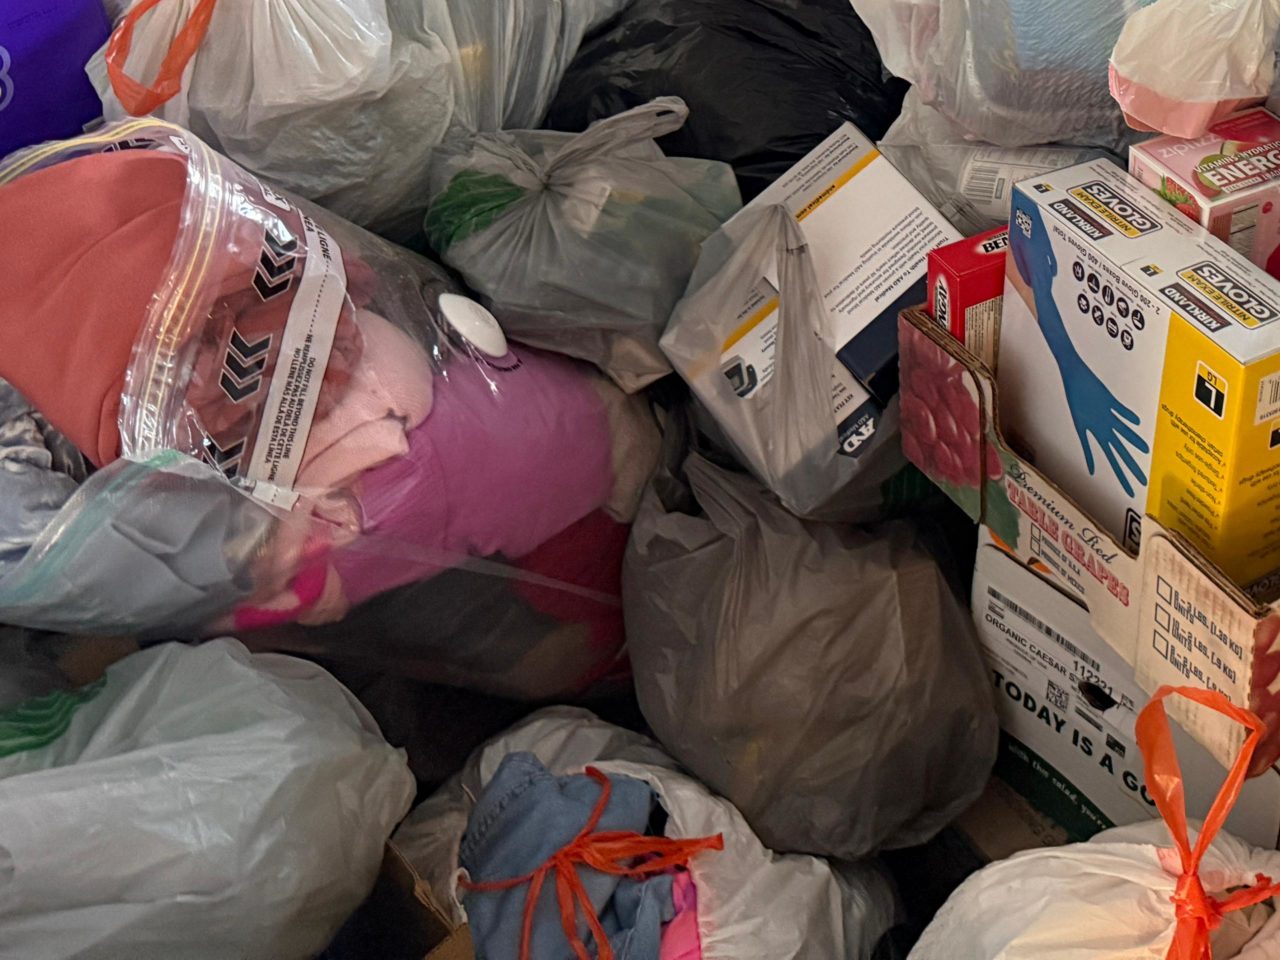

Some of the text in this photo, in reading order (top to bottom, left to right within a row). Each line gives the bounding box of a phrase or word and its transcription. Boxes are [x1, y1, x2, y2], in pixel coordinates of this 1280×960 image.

[1194, 155, 1240, 173] VITAMINS
[1052, 199, 1105, 239] KIRKLAND
[1075, 189, 1136, 237] NITRILE EXAM
[1084, 182, 1160, 233] GLOVES
[892, 275, 905, 287] A&D
[909, 255, 926, 272] Health
[873, 284, 895, 303] Medical
[934, 278, 951, 328] NGAY
[1163, 286, 1221, 332] KIRKLAND
[1184, 271, 1252, 327] NITRILE EXAM
[1194, 265, 1272, 322] GLOVES
[1205, 381, 1218, 409] L
[1206, 368, 1218, 385] LG
[285, 357, 316, 459] DO NOT FILL BEYOND THIS LINE
[1010, 463, 1119, 565] Premium Red
[1006, 478, 1130, 608] TABLE GRAPES
[985, 613, 1028, 648] ORGANIC
[1029, 644, 1067, 676] CAESAR
[992, 669, 1067, 734] TODAY
[1072, 729, 1094, 757] IS
[1098, 752, 1115, 775] A
[1122, 770, 1157, 807] GO
